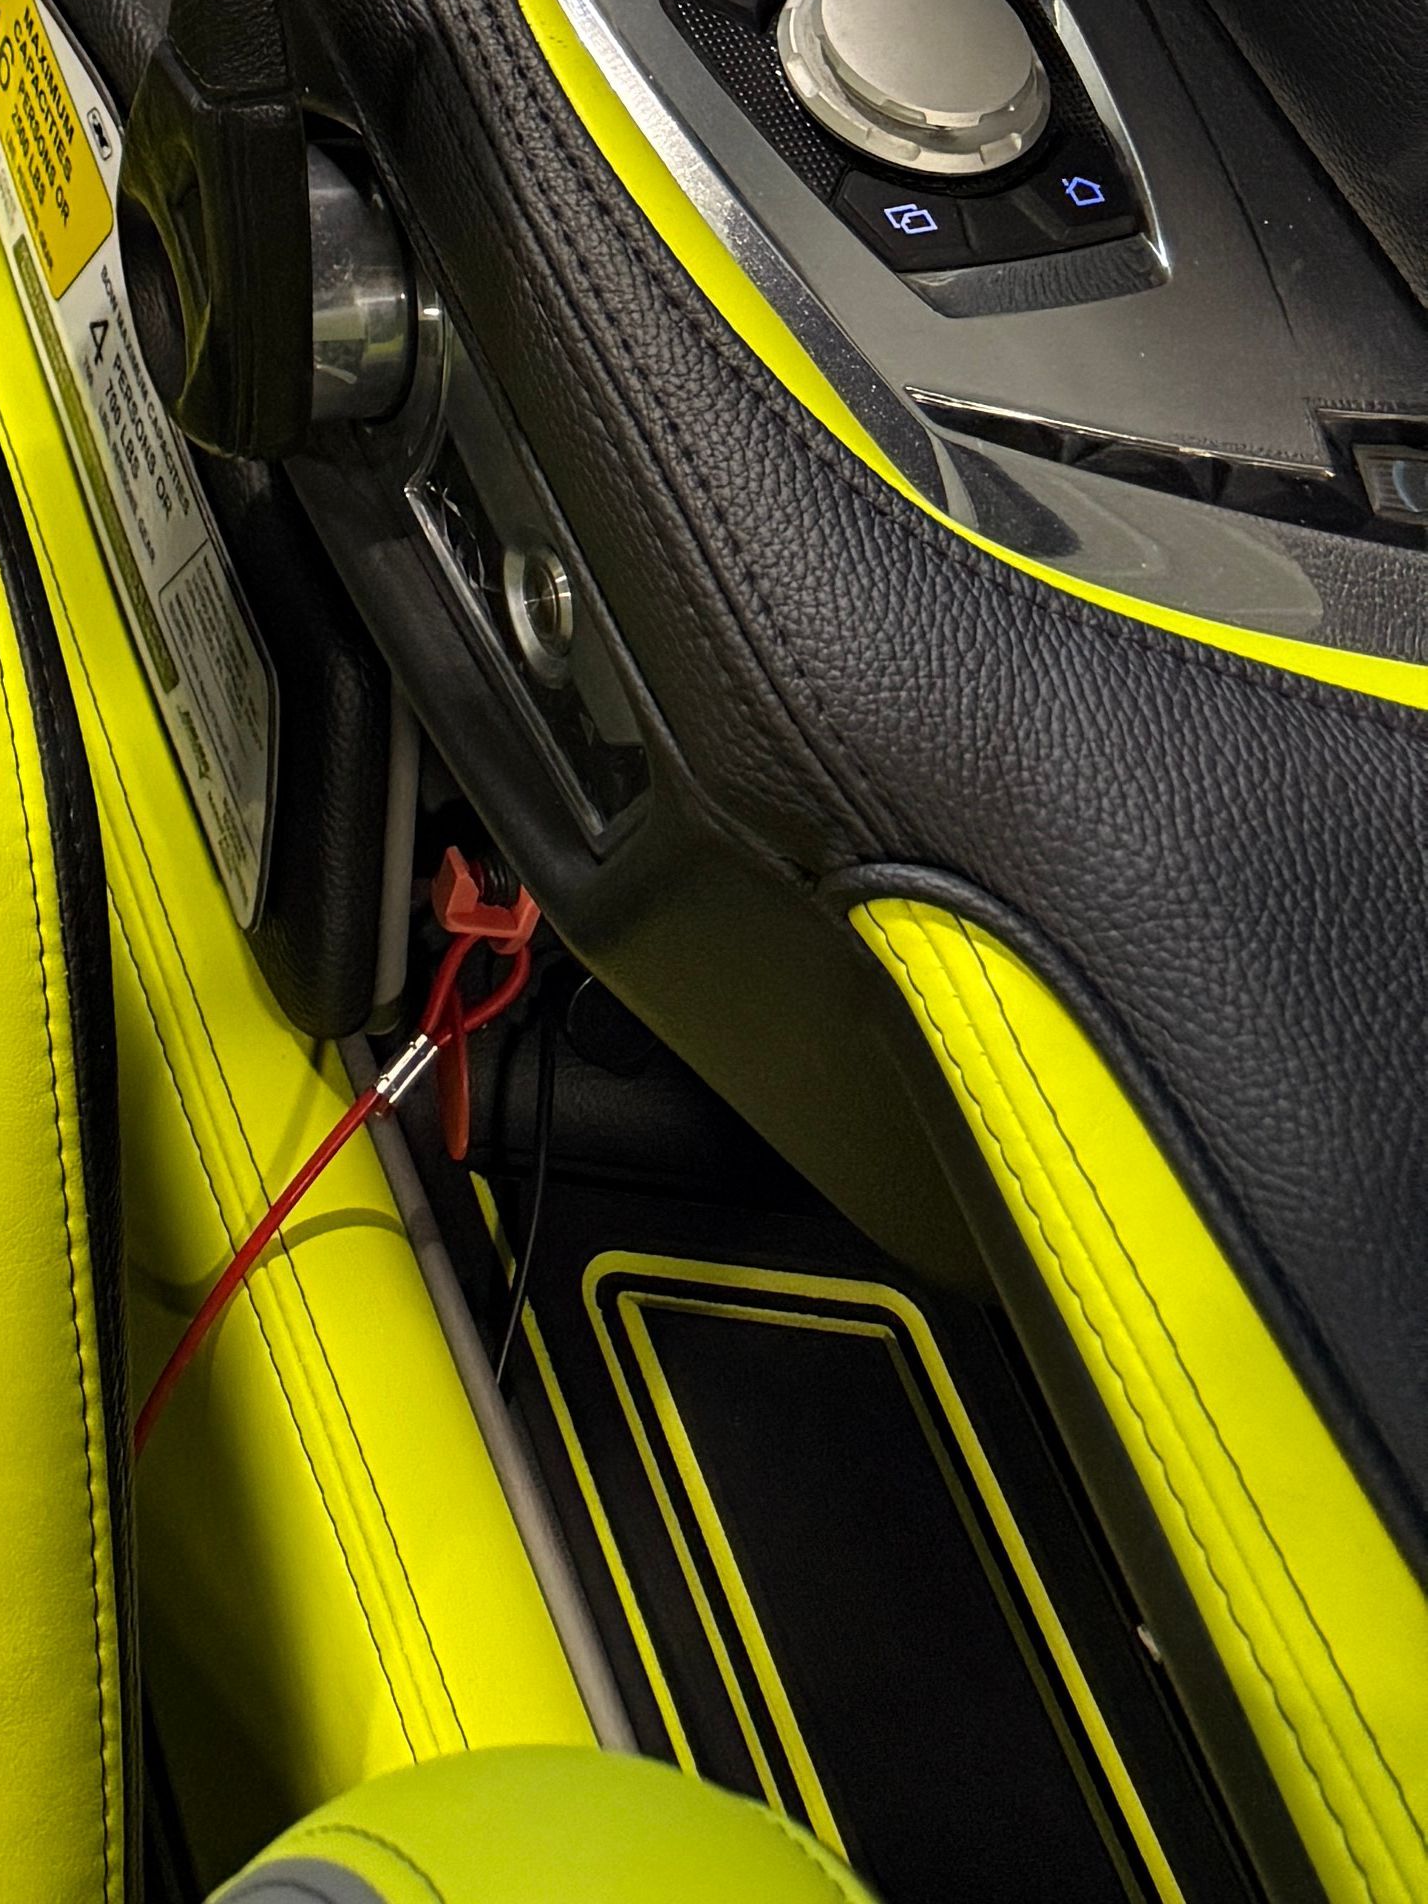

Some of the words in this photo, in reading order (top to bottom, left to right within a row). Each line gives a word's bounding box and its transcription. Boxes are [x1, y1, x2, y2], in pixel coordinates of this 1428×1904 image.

[13, 19, 73, 183] CAPACITIES
[23, 5, 75, 145] MAXIMUM
[17, 78, 56, 188] PERSONS
[56, 184, 70, 228] OR
[29, 152, 46, 206] LBS
[88, 318, 110, 366] 4
[113, 349, 155, 479] PERSONS
[156, 473, 174, 524] OR
[104, 376, 121, 427] 700
[119, 421, 140, 481] LBS
[117, 307, 148, 405] MAXIMUM
[149, 397, 188, 520] CAPACITIES
